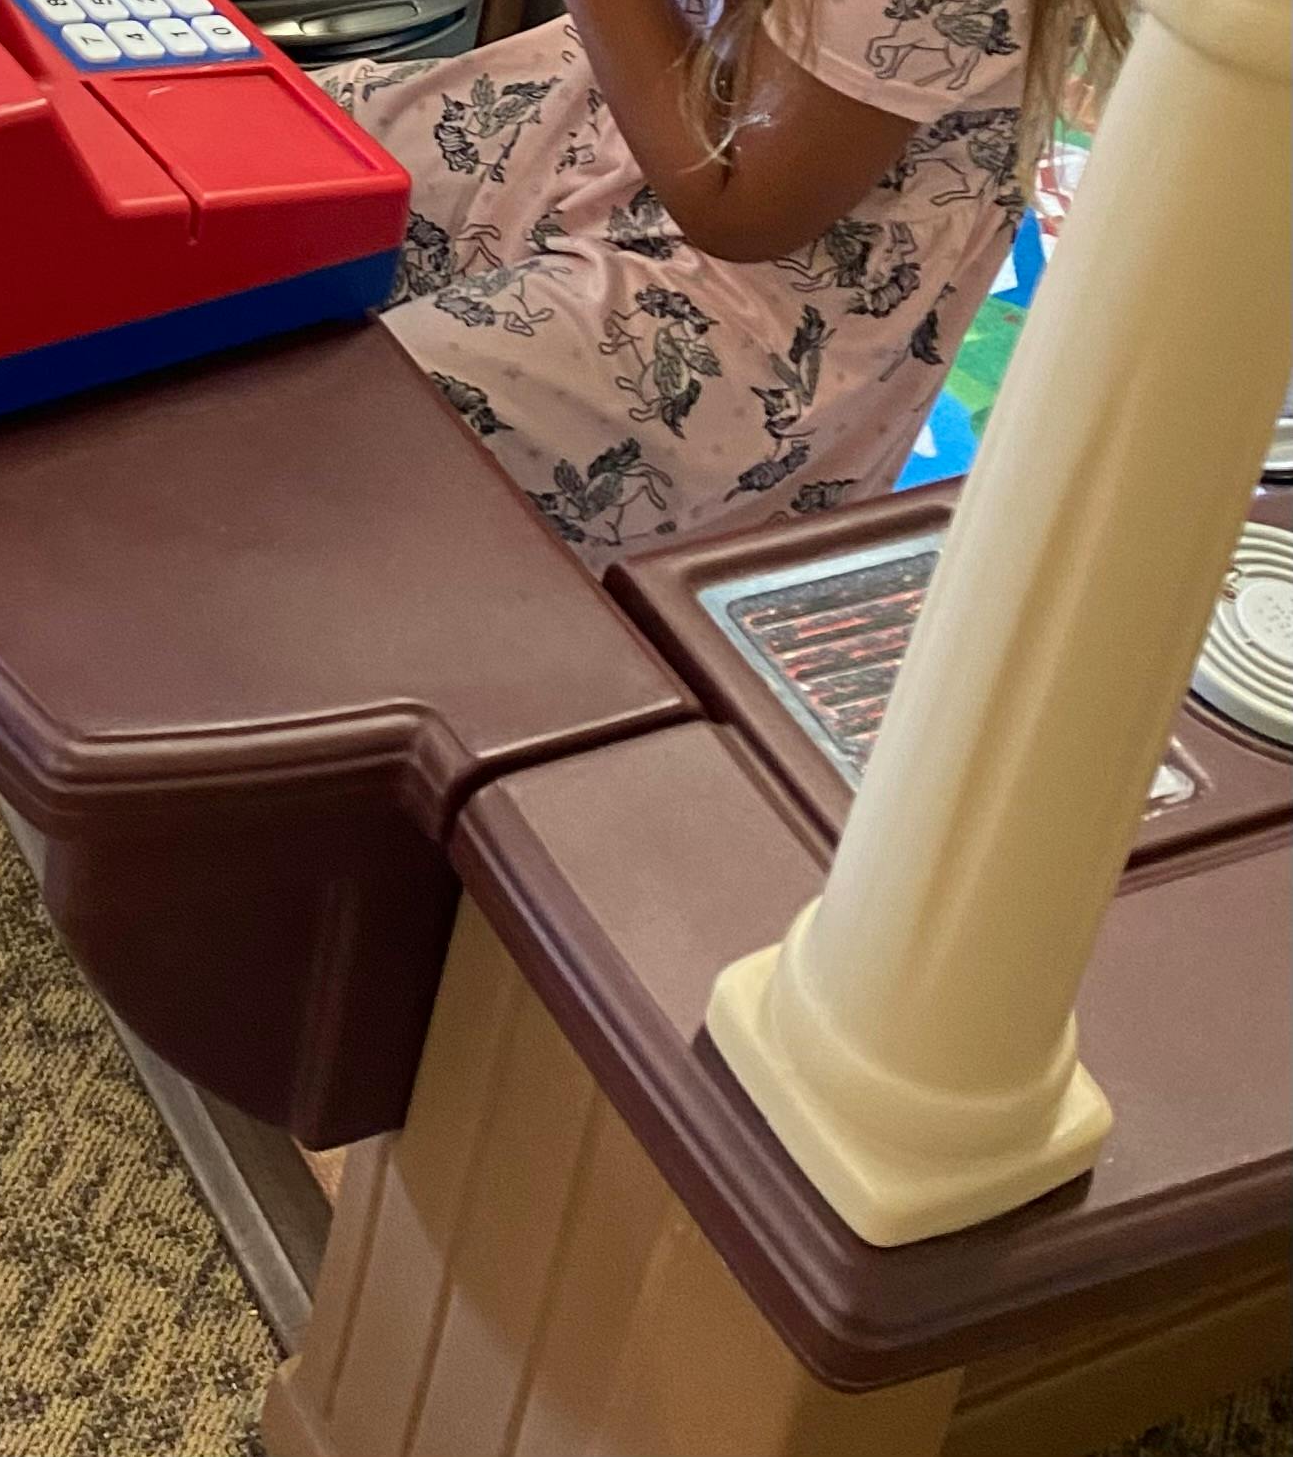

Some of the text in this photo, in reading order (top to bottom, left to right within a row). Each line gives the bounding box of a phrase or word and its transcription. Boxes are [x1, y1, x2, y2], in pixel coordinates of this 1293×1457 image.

[170, 30, 188, 38] 1
[212, 27, 232, 36] 0
[81, 35, 103, 47] 7
[126, 32, 146, 41] 4
